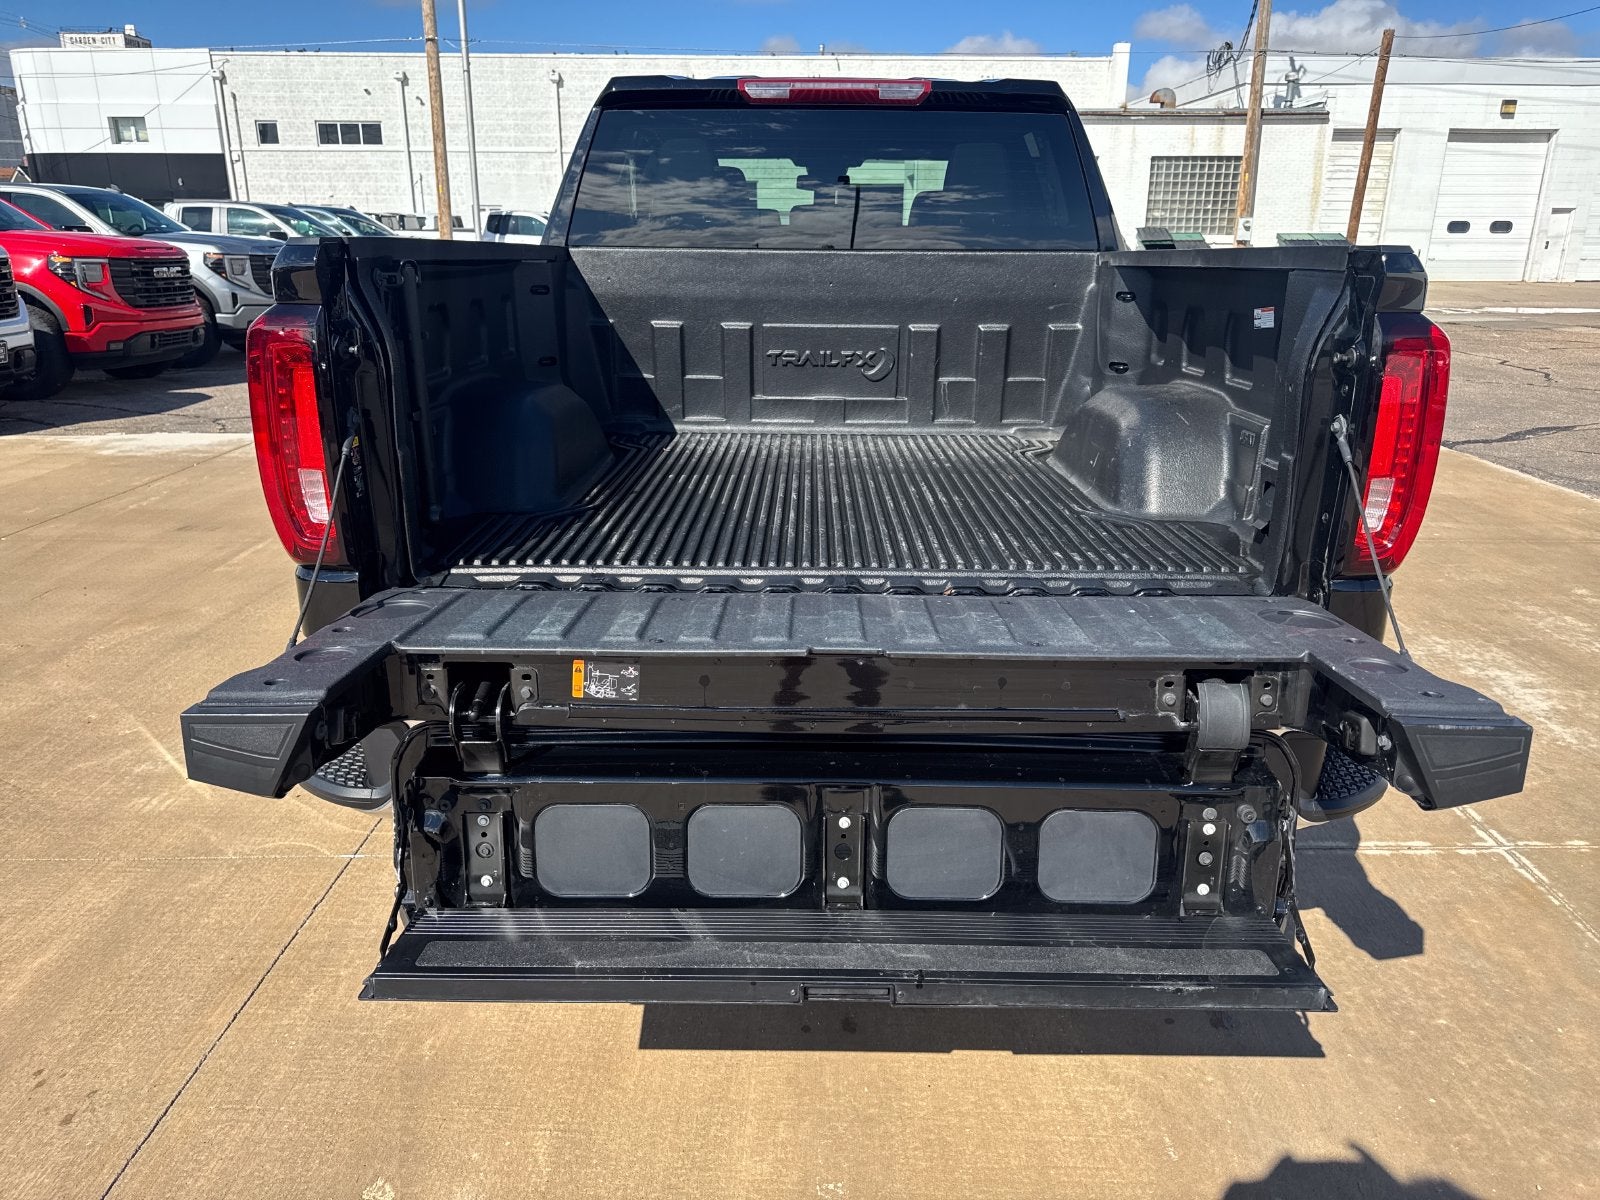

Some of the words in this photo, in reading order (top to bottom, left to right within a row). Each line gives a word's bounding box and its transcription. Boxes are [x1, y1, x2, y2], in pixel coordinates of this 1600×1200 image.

[69, 36, 97, 45] GARDEN
[100, 36, 116, 45] CITY
[153, 266, 182, 278] GMC
[766, 349, 877, 368] TRAILFX
